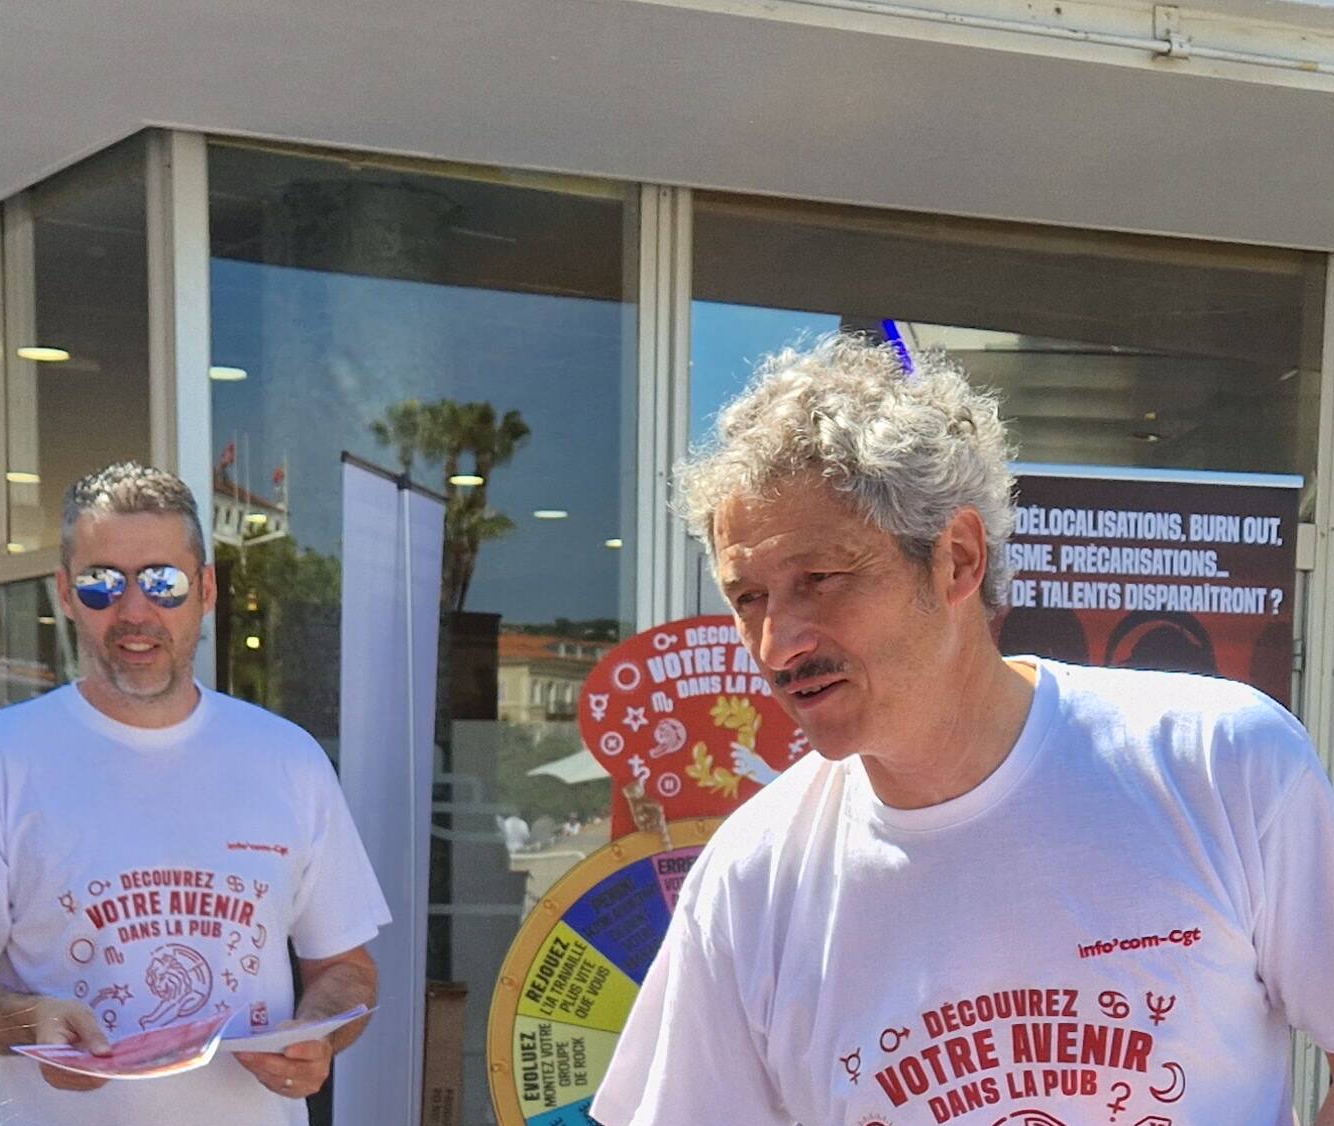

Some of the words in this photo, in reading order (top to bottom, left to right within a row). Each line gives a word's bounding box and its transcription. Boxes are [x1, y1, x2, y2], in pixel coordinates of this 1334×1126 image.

[1016, 504, 1186, 542] DÉLOCALISATIONS,
[1190, 514, 1241, 543] BURN
[1011, 579, 1036, 608] DE
[1040, 580, 1121, 610] TALENTS
[1270, 588, 1283, 615] ?
[647, 646, 726, 683] VOTRE
[676, 675, 722, 698] DANS
[725, 674, 746, 694] LA
[85, 891, 162, 930] VOTRE
[169, 890, 254, 927] AVENIR
[117, 920, 161, 944] DANS
[165, 919, 183, 936] LA
[189, 919, 222, 938] PUB
[525, 937, 570, 1003] REJOUEZ
[551, 940, 587, 996] TRAVAILLE
[559, 984, 583, 1013] PLUS
[575, 958, 596, 984] VITE
[575, 996, 595, 1019] QUE
[587, 966, 610, 996] VOUS
[921, 989, 1079, 1039] DÉCOUVREZ
[539, 1023, 555, 1061] VOTRE
[556, 1041, 571, 1087] GROUPE
[572, 1037, 586, 1069] ROCK
[520, 1032, 540, 1102] EVOLUEZ
[541, 1062, 557, 1107] MONTEZ
[575, 1071, 587, 1086] DE
[875, 1028, 1000, 1108] VOTRE
[1011, 1022, 1153, 1073] AVENIR
[928, 1077, 1001, 1124] DANS
[1006, 1070, 1038, 1100] LA
[1043, 1069, 1098, 1097] PUB
